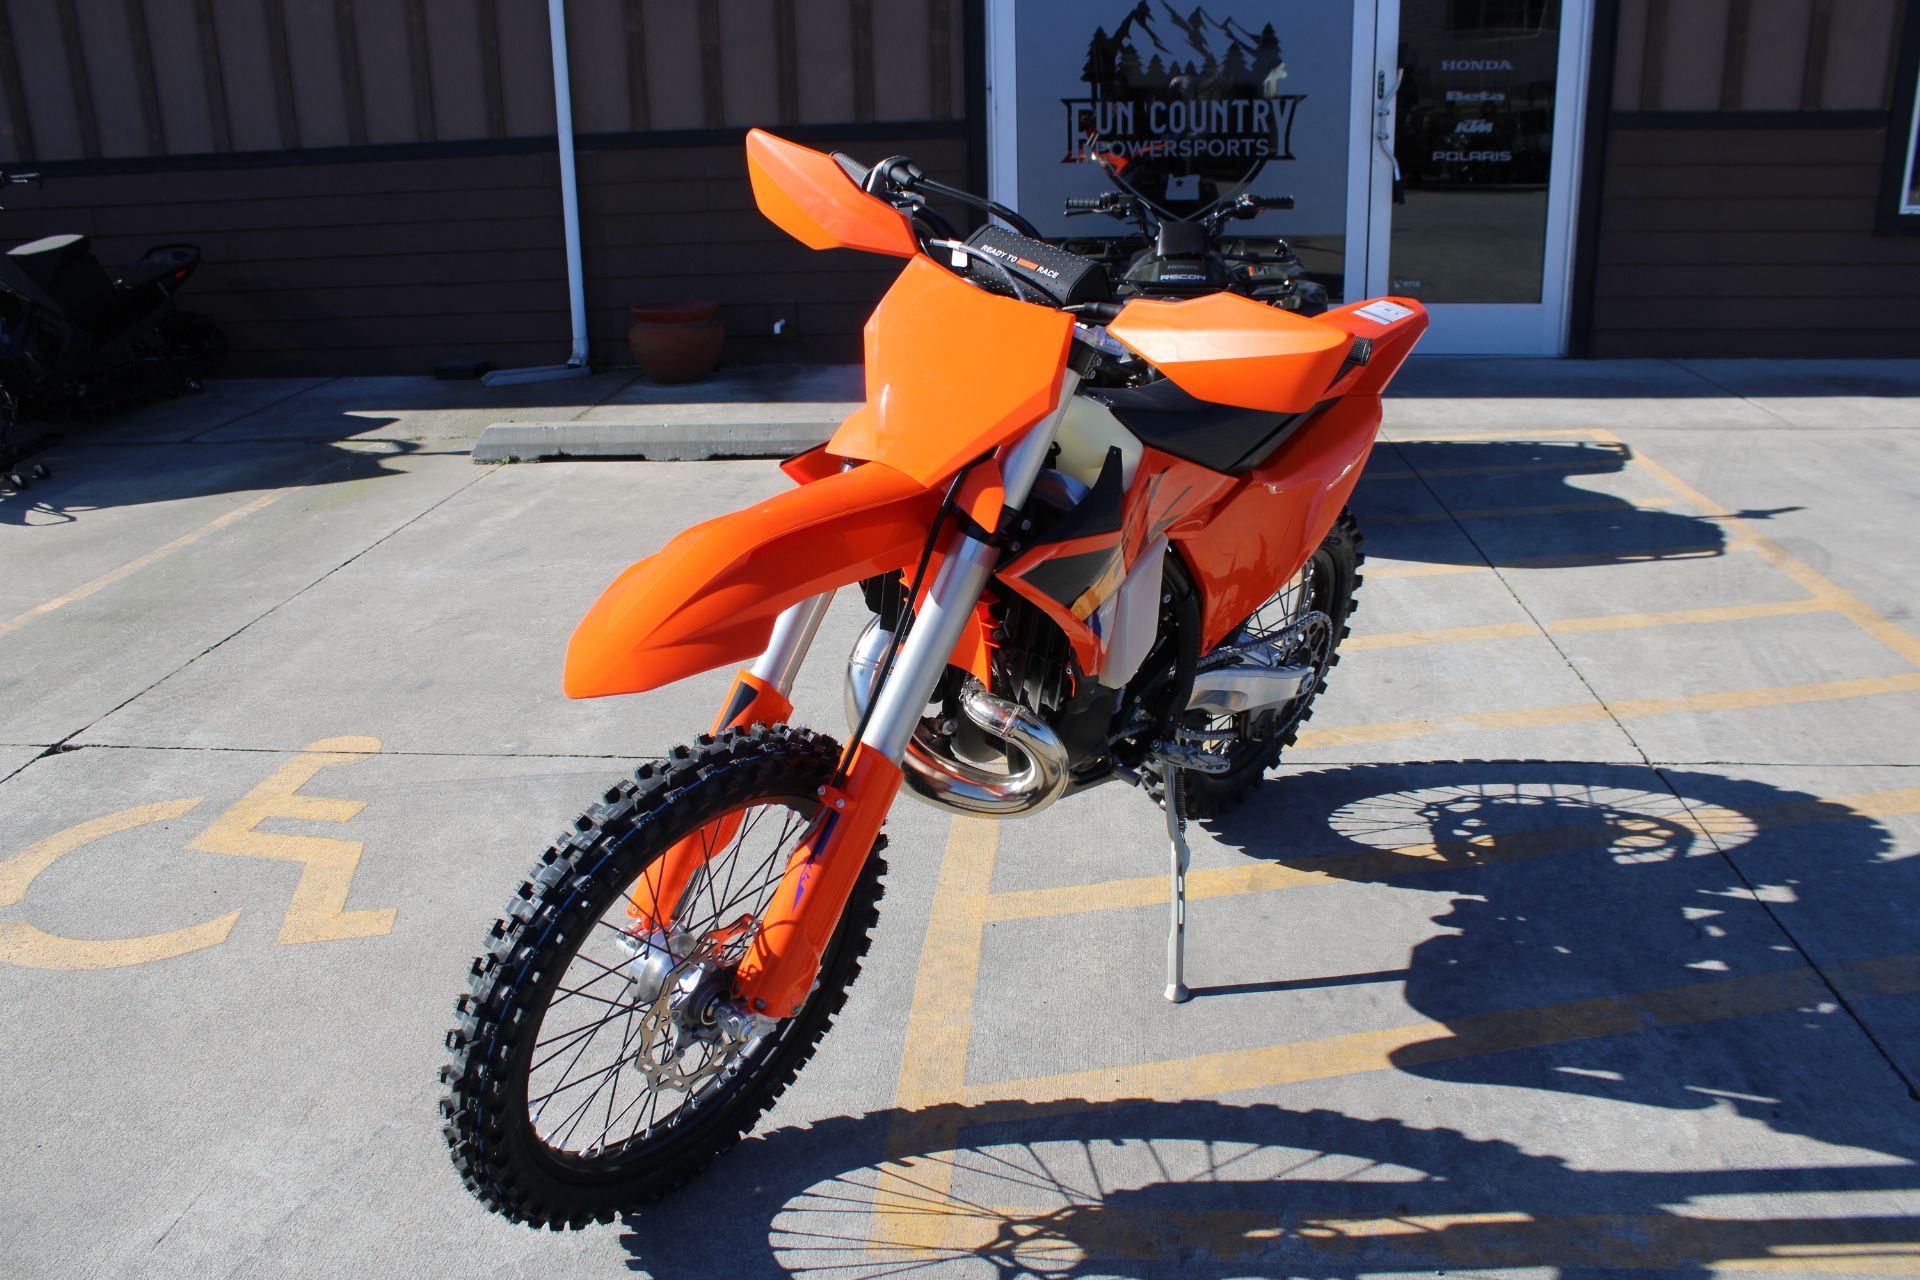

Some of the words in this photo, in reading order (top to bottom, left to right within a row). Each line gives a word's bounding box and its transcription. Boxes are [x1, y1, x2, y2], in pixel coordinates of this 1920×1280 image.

[1441, 60, 1512, 70] HONDA
[1446, 91, 1505, 102] Beta
[1070, 102, 1134, 159] FUN
[1151, 100, 1296, 156] COUNTRY
[1455, 119, 1494, 133] KTM
[1095, 139, 1269, 157] POWERSPORTS
[1432, 151, 1512, 162] POLARIS
[980, 244, 1007, 258] READY
[1006, 254, 1018, 263] TO
[1036, 265, 1060, 279] RACE
